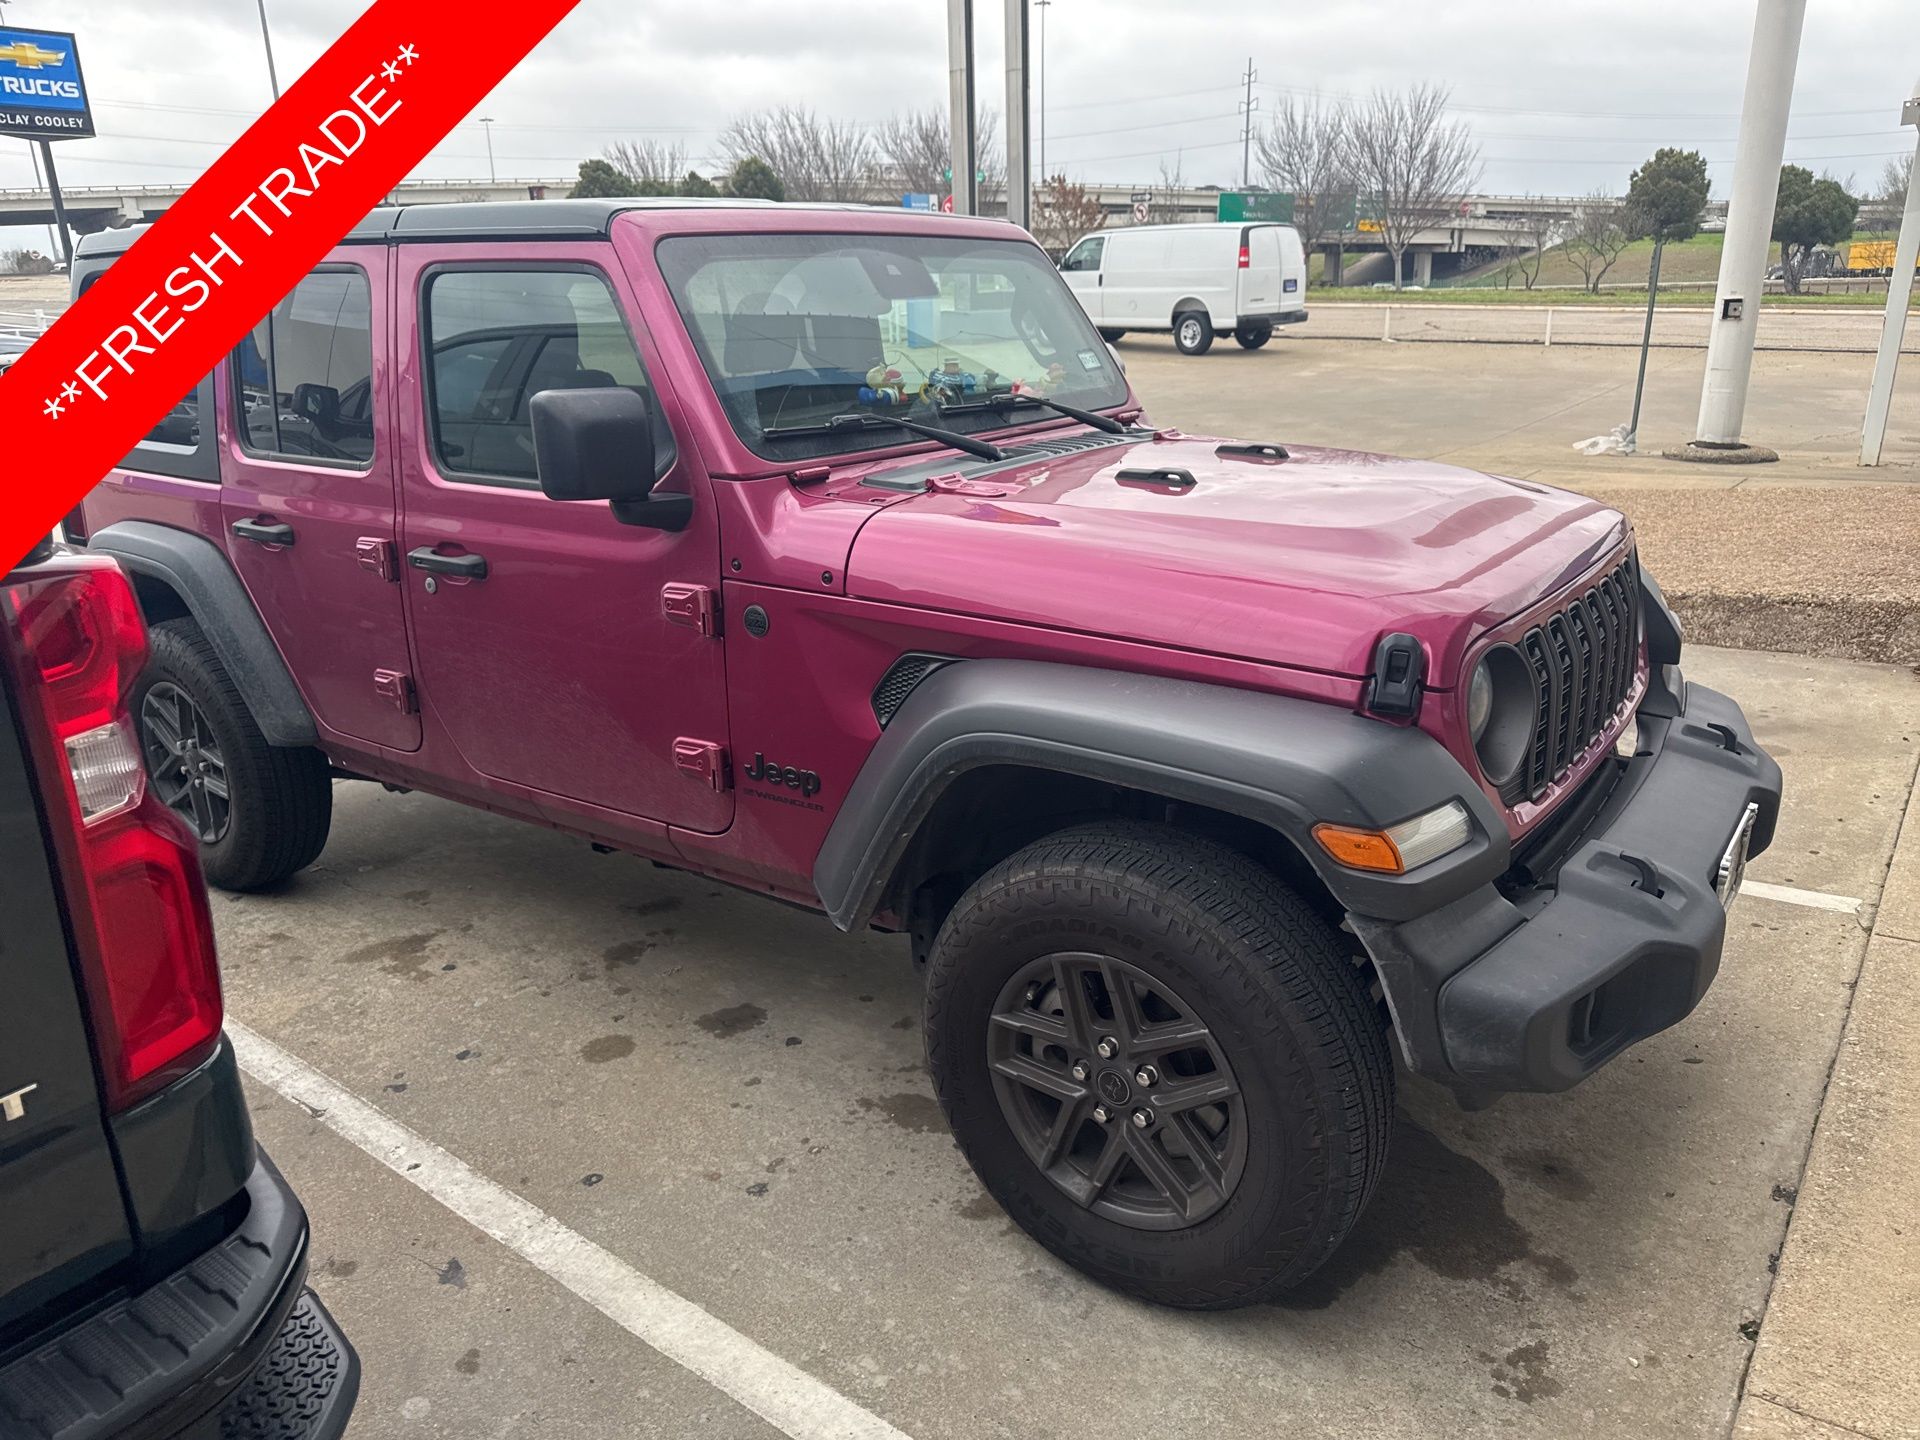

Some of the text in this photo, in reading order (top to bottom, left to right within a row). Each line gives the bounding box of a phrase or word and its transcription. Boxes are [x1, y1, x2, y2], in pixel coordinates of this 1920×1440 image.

[34, 115, 84, 128] COOLEY
[744, 752, 821, 797] Jeep
[754, 789, 825, 812] WRANGLER
